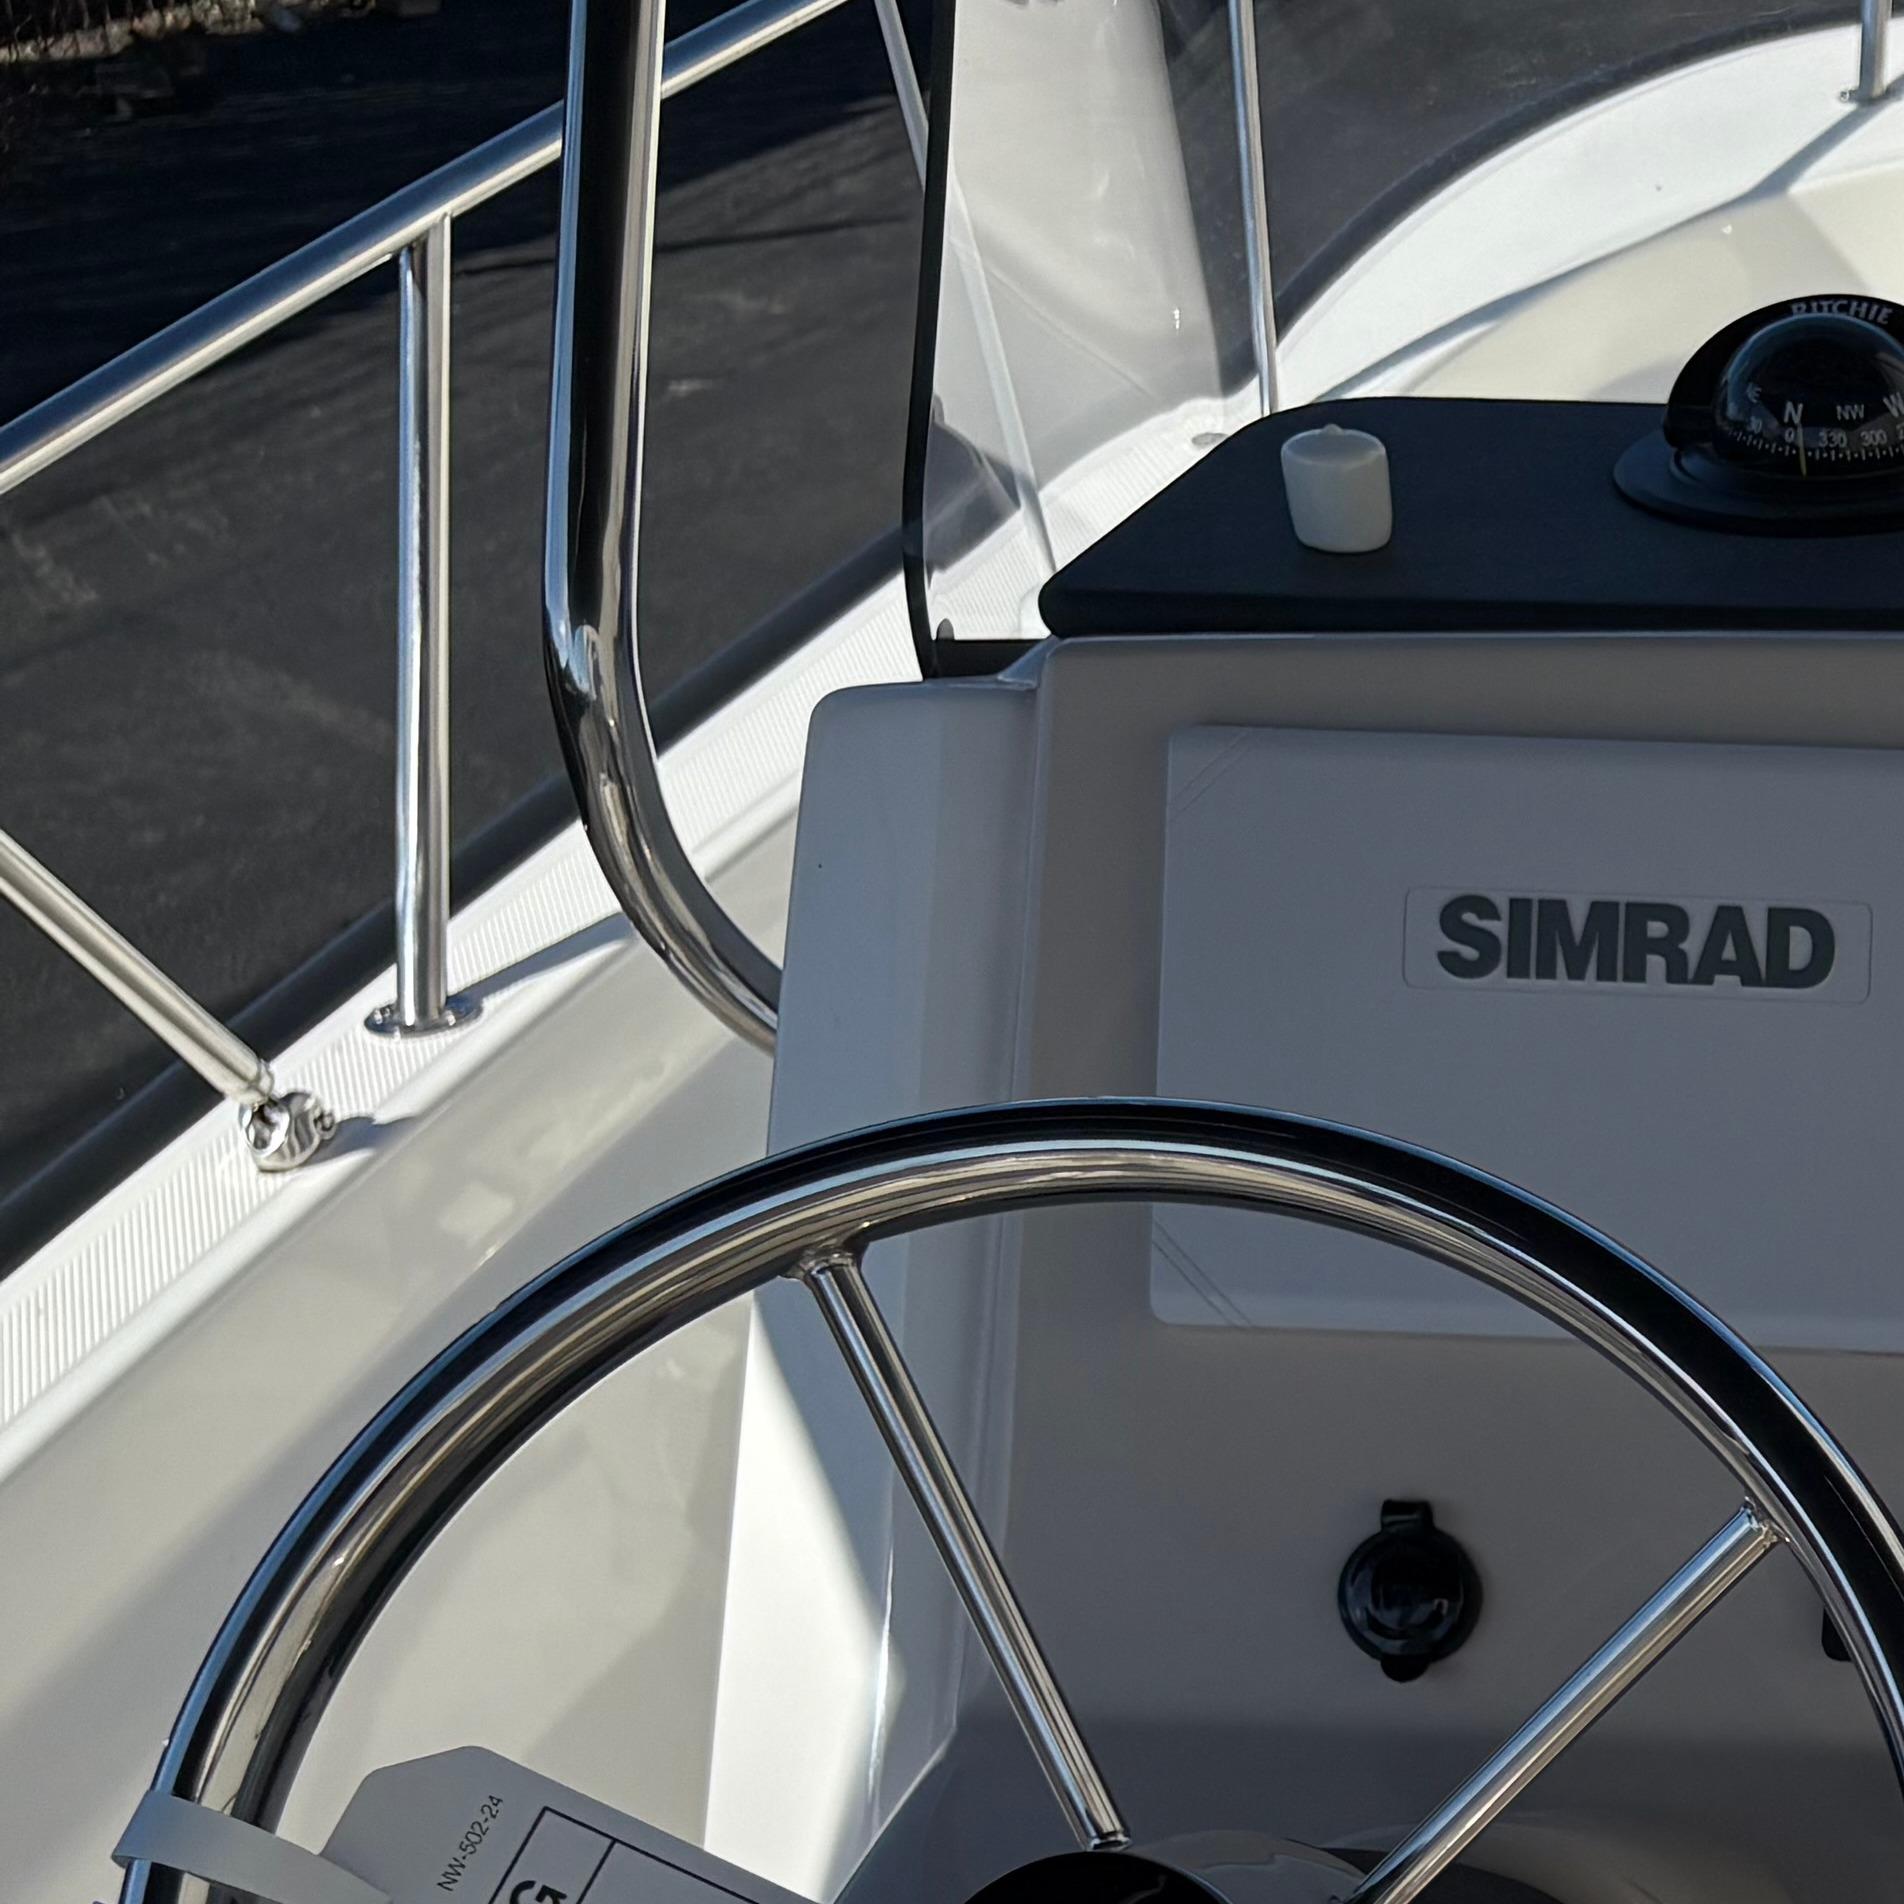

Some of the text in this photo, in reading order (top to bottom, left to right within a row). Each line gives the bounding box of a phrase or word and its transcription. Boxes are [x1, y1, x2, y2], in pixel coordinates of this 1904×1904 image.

[1790, 300, 1893, 325] RITCHIE
[1784, 401, 1803, 424] N
[1836, 404, 1864, 421] NW
[1819, 432, 1847, 447] 330
[1861, 429, 1887, 446] 300
[1437, 893, 1837, 989] SIMRAD
[436, 1794, 503, 1891] NW-502-24
